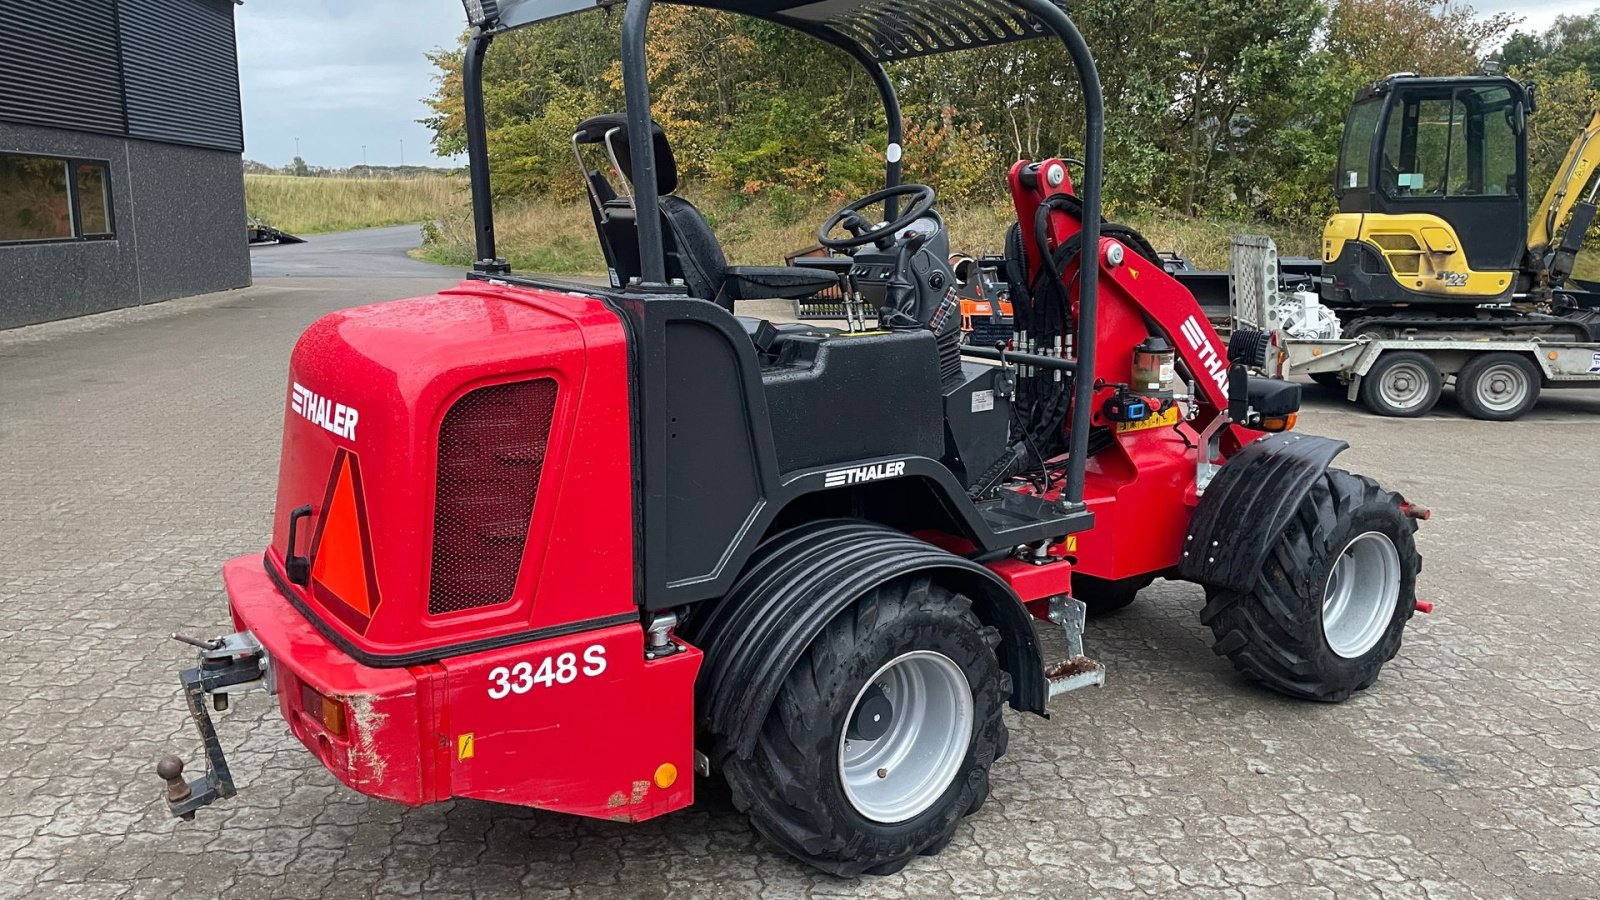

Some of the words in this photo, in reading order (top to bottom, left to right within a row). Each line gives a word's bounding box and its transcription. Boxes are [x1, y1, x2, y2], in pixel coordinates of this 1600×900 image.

[302, 388, 359, 442] THALER
[846, 461, 905, 484] THALER
[487, 652, 578, 699] 3348
[582, 644, 607, 677] S
